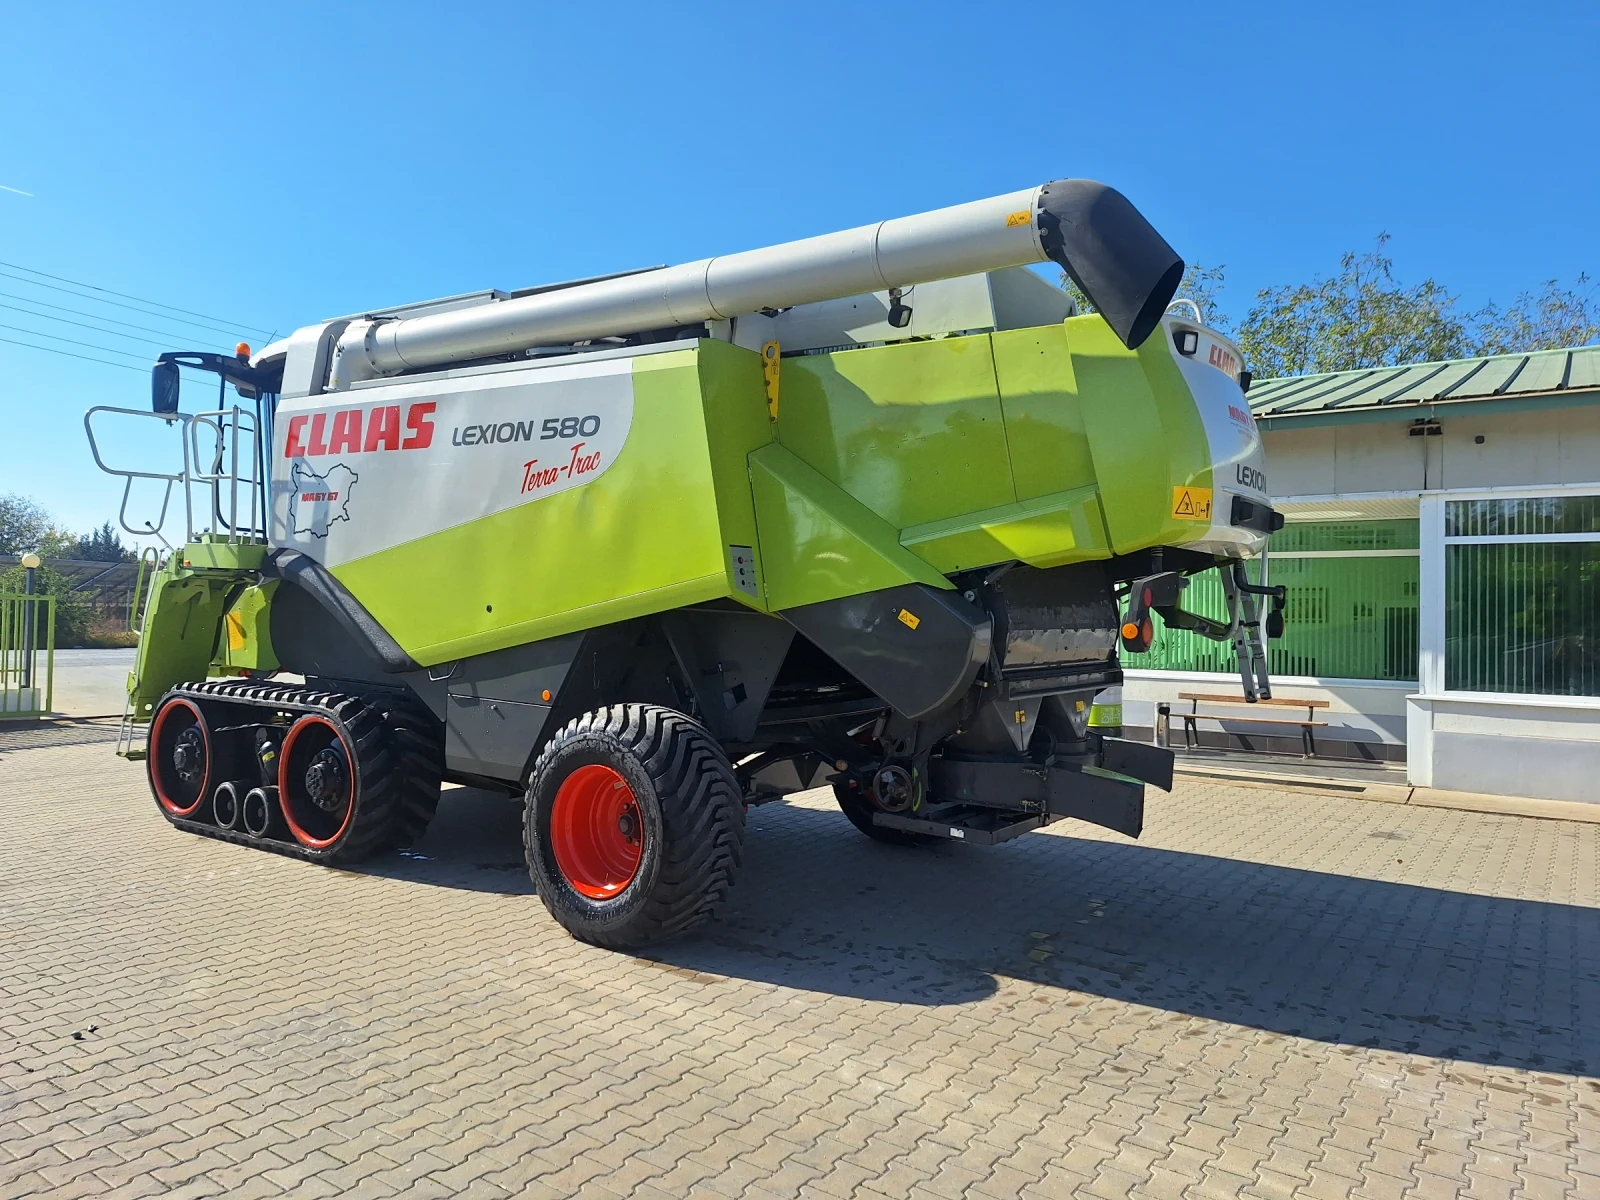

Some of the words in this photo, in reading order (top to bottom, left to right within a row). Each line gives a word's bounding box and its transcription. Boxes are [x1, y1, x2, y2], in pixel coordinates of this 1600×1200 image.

[284, 401, 437, 459] CLAAS
[451, 420, 535, 447] LEXION
[539, 415, 601, 440] 580
[520, 442, 601, 495] Terra-Trac
[1236, 463, 1267, 494] LEXION
